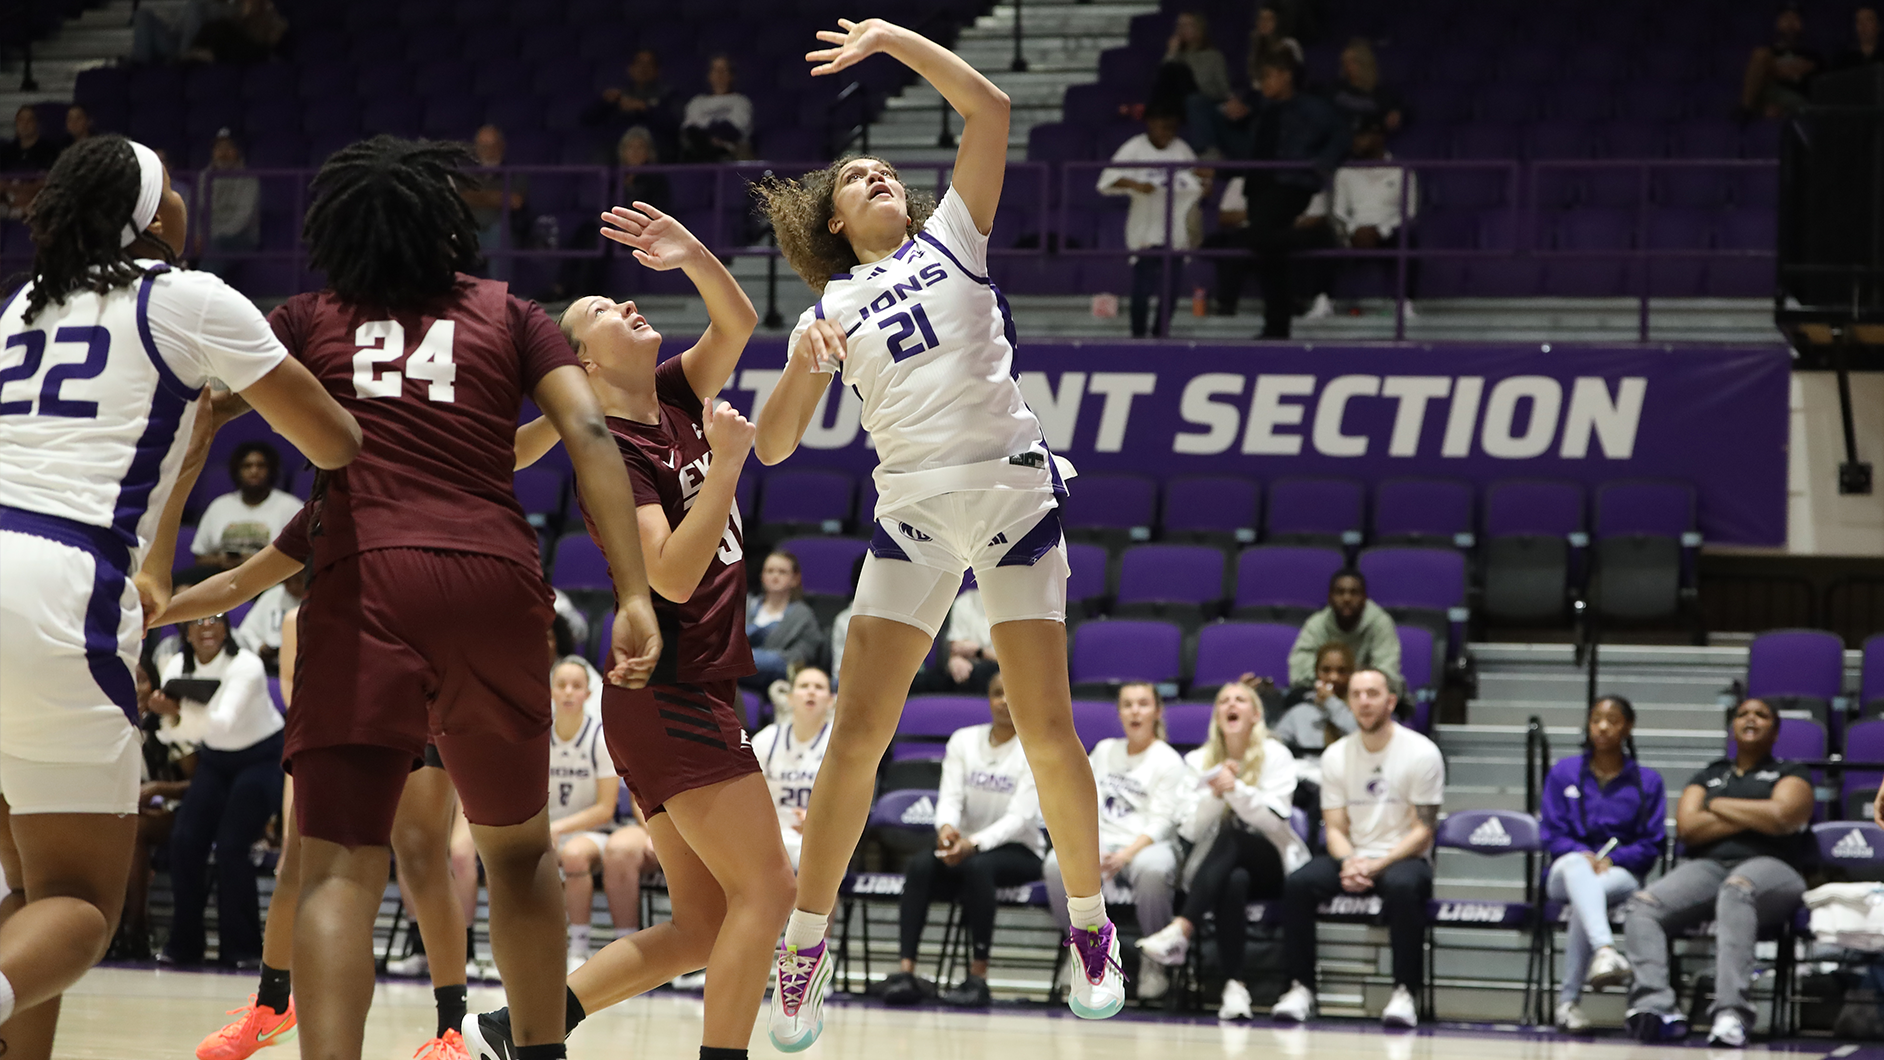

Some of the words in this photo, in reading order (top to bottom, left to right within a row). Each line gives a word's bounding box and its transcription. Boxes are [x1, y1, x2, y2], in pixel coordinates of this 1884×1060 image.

[352, 319, 457, 403] 24
[877, 303, 940, 364] 21
[0, 325, 111, 419] 22
[712, 370, 1157, 453] TUNT
[1173, 373, 1648, 459] SECTION
[779, 787, 812, 809] 20
[853, 875, 906, 895] LION
[1436, 903, 1507, 922] LIONS
